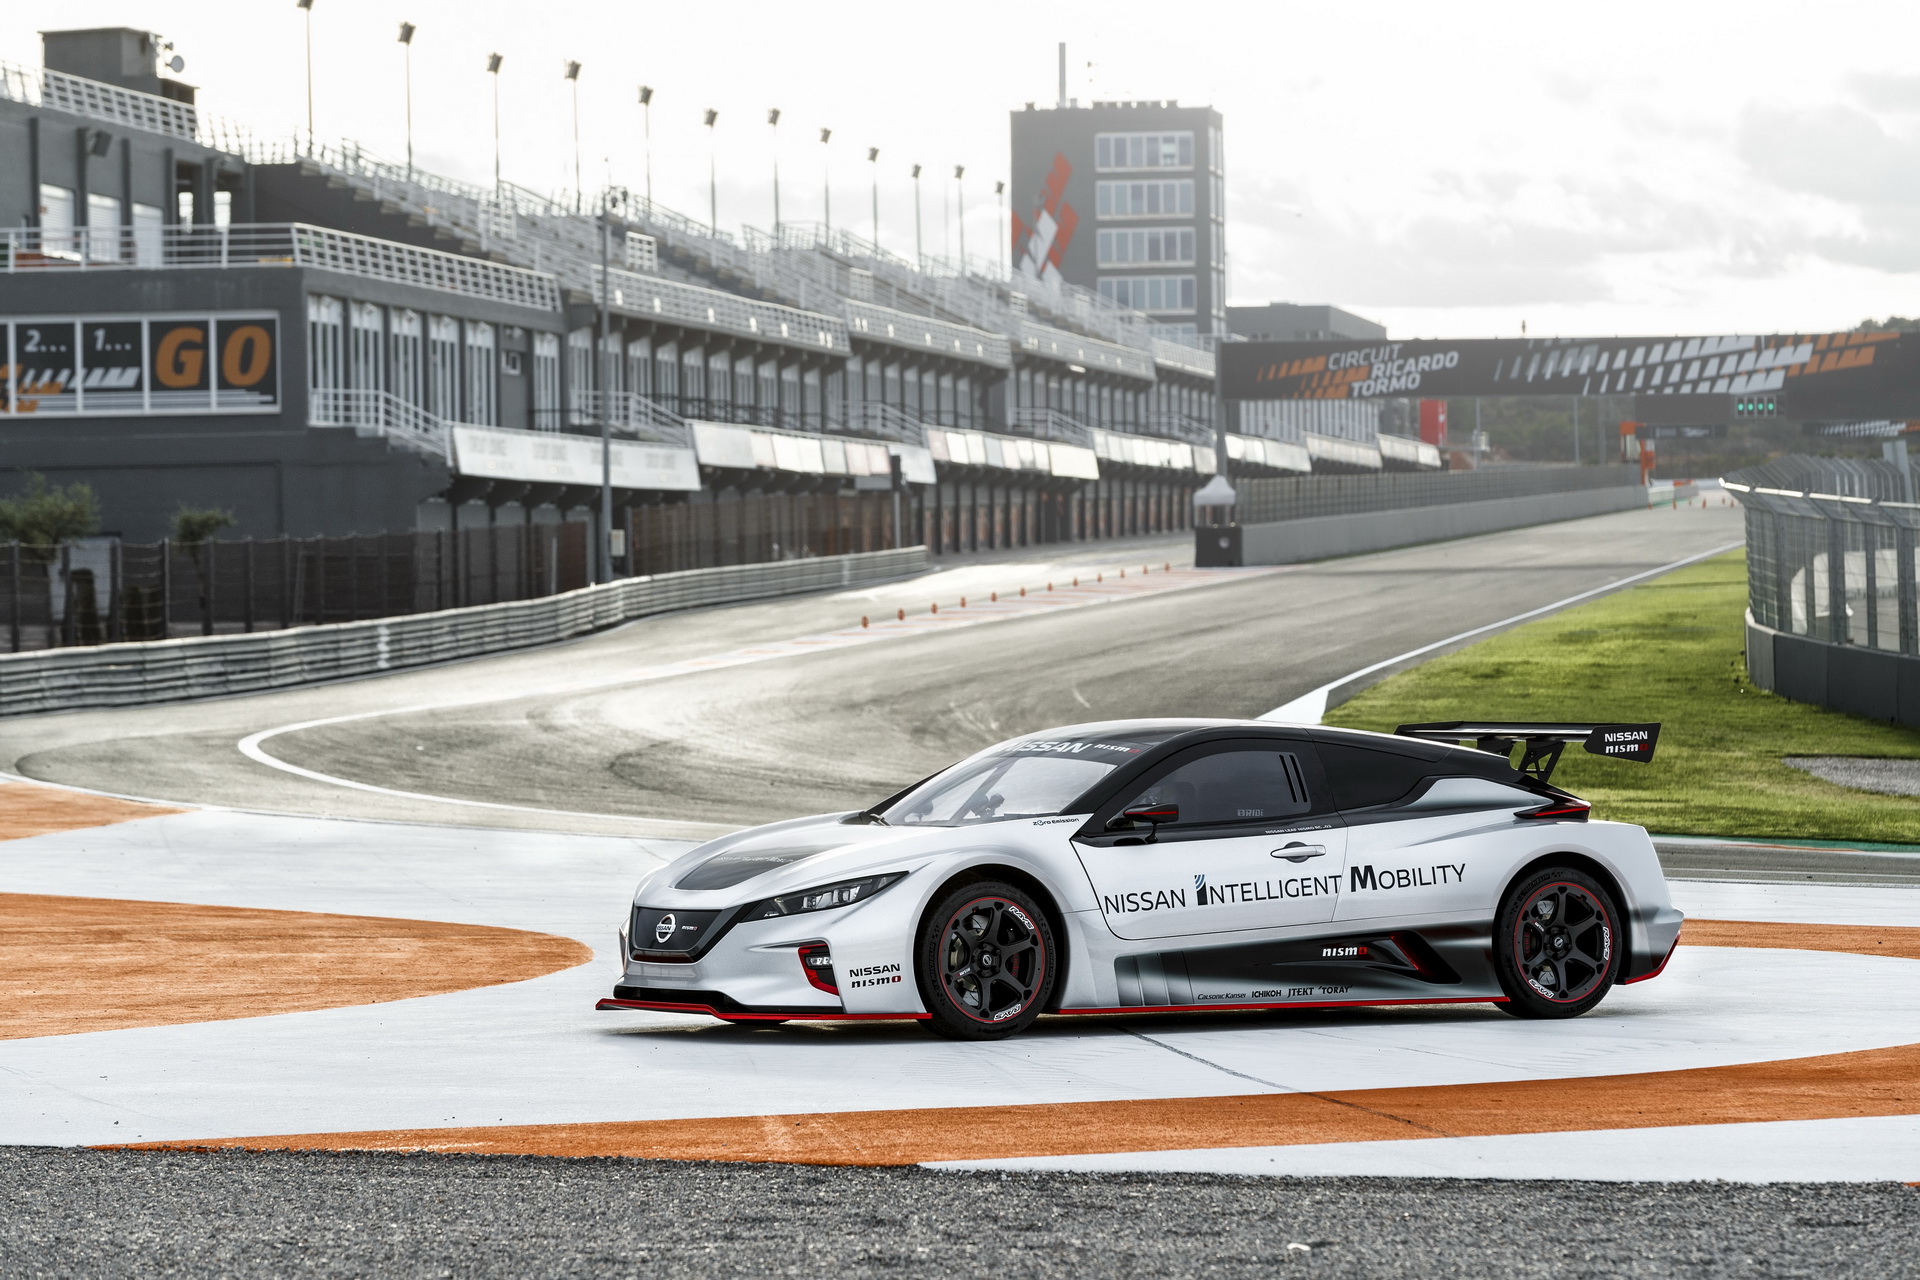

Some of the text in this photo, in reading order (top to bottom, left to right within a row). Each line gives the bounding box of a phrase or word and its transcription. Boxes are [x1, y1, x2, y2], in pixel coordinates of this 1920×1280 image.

[155, 325, 272, 388] GO
[1328, 343, 1403, 371] CIRCUIT
[1370, 351, 1459, 380] RICARDO
[1351, 372, 1421, 397] TORMO
[1604, 730, 1648, 743] NISSAN
[1104, 863, 1466, 915] NISSAN INTELLIGENT MOBILITY
[1009, 905, 1035, 931] RAYS
[1602, 926, 1611, 961] RAYS
[849, 963, 901, 978] NISSAN
[1251, 989, 1282, 998] ICHIKOH
[1287, 987, 1315, 998] JTEKT
[1528, 979, 1554, 999] RAYS
[994, 1003, 1021, 1021] RAYS
